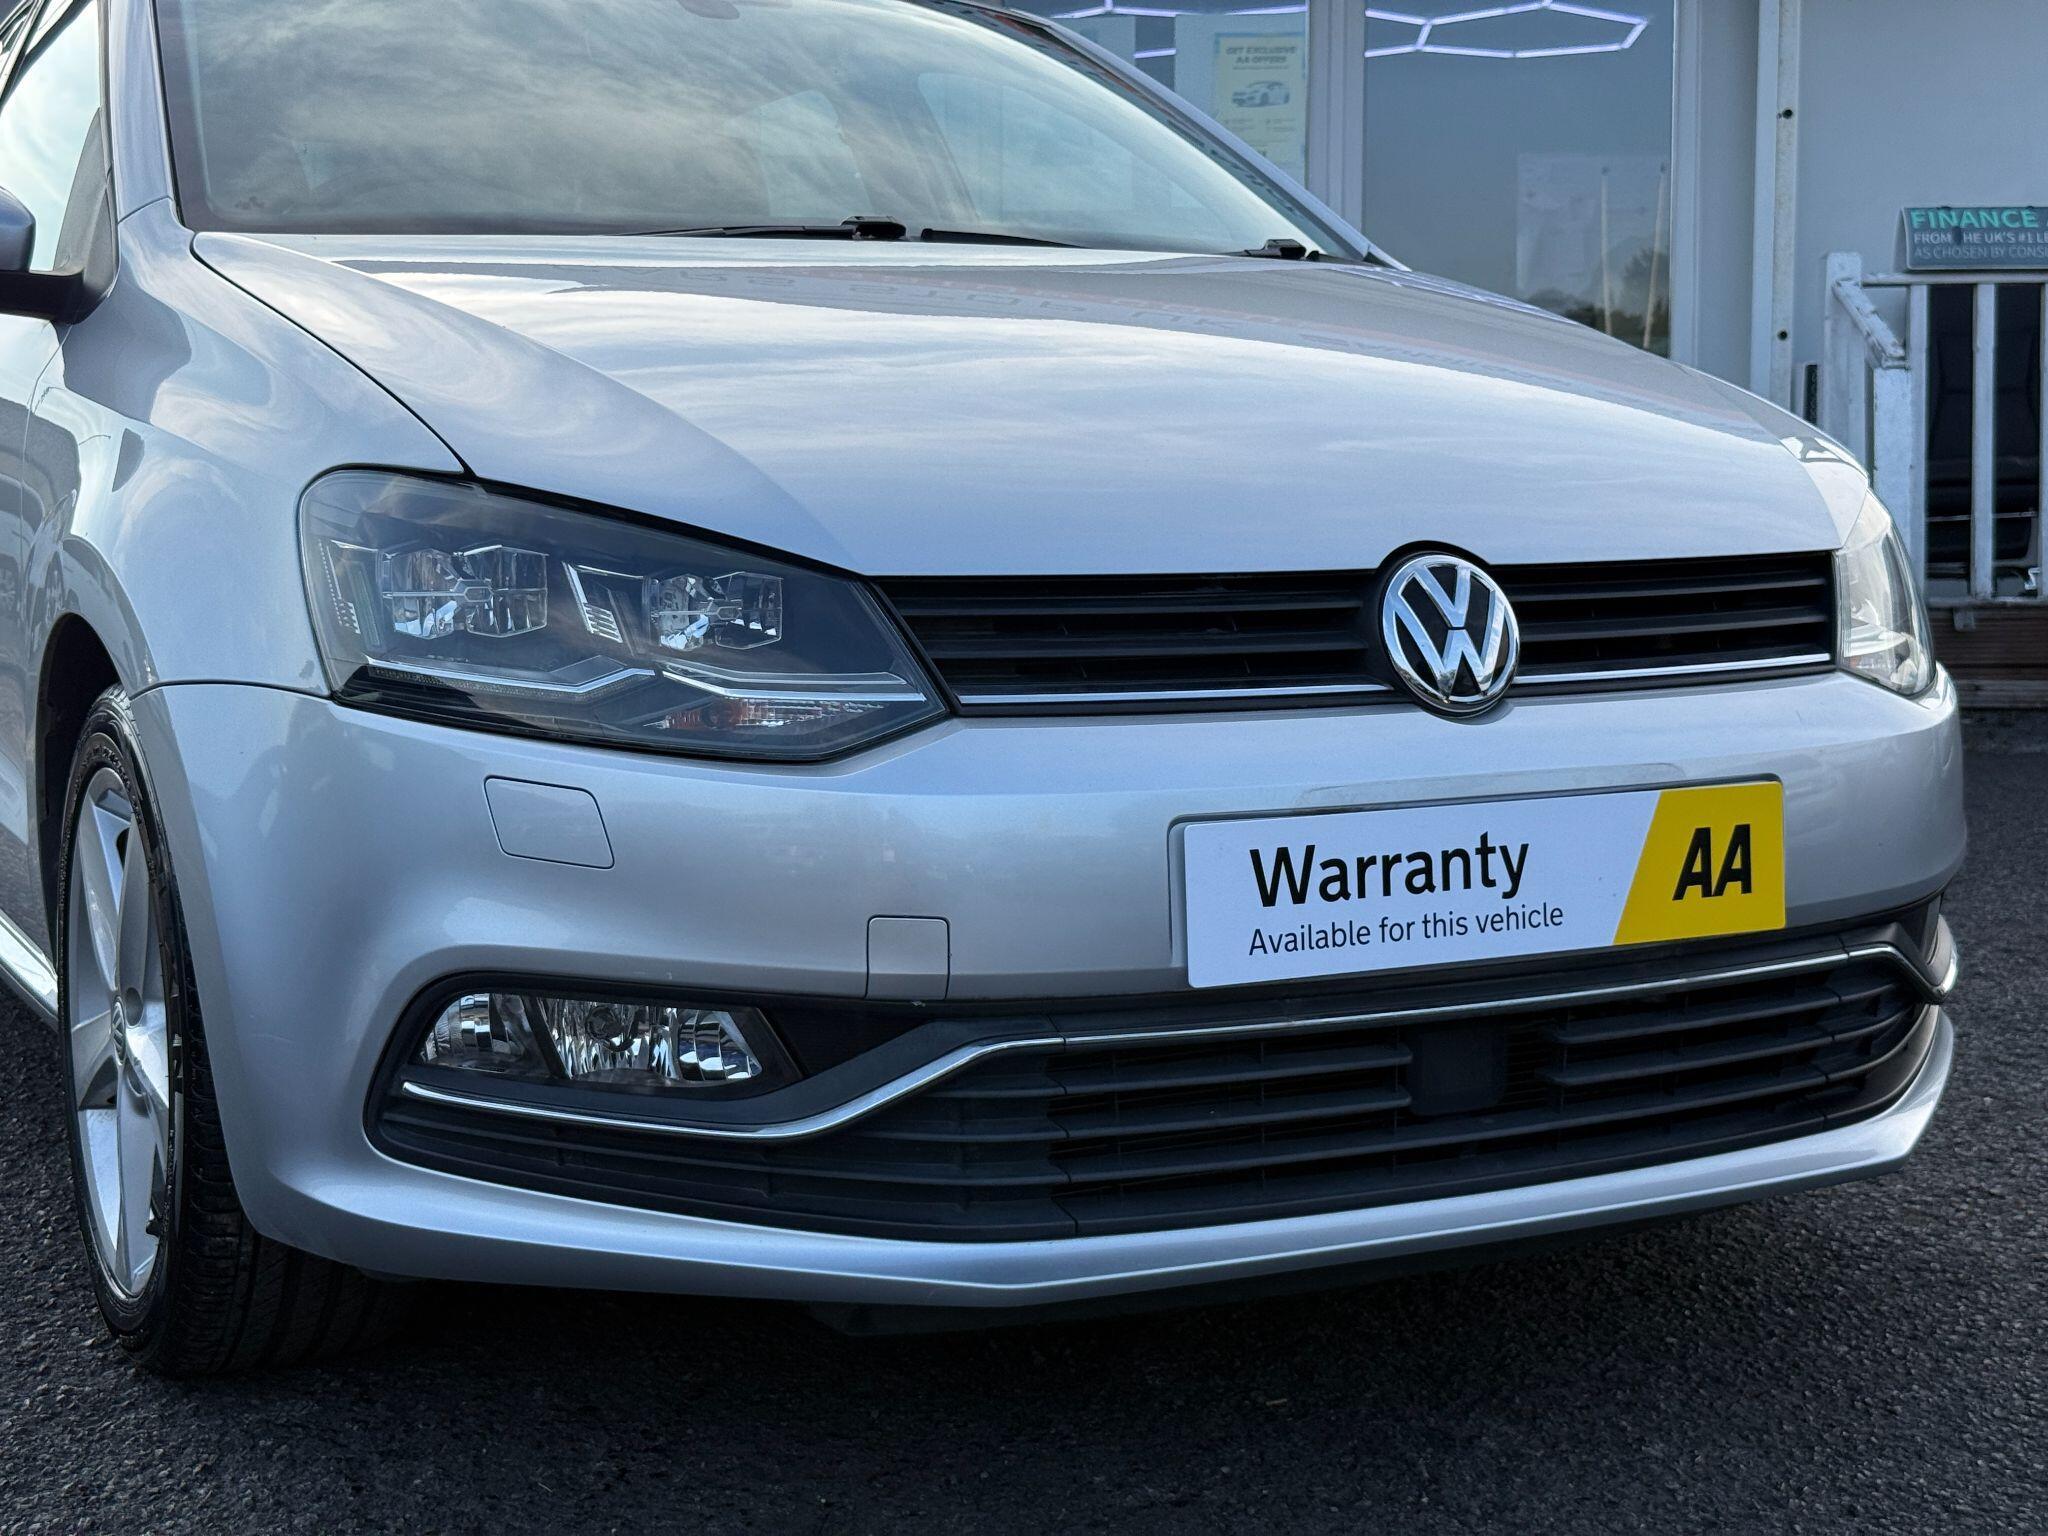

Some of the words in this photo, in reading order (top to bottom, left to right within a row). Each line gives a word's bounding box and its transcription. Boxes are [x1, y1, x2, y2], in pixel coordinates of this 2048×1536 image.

[1911, 209, 2039, 229] FINANCE
[1913, 231, 1951, 244] FROM
[1984, 231, 2015, 243] UK'S
[1914, 247, 1931, 258] AS
[1933, 246, 1988, 259] CHOSEN
[1990, 246, 2005, 258] BY
[1249, 831, 1529, 908] Warranty
[1671, 823, 1753, 901] AA
[1249, 919, 1371, 956] Available
[1379, 916, 1417, 943] for
[1422, 911, 1468, 939] this
[1475, 902, 1563, 933] vehicle
